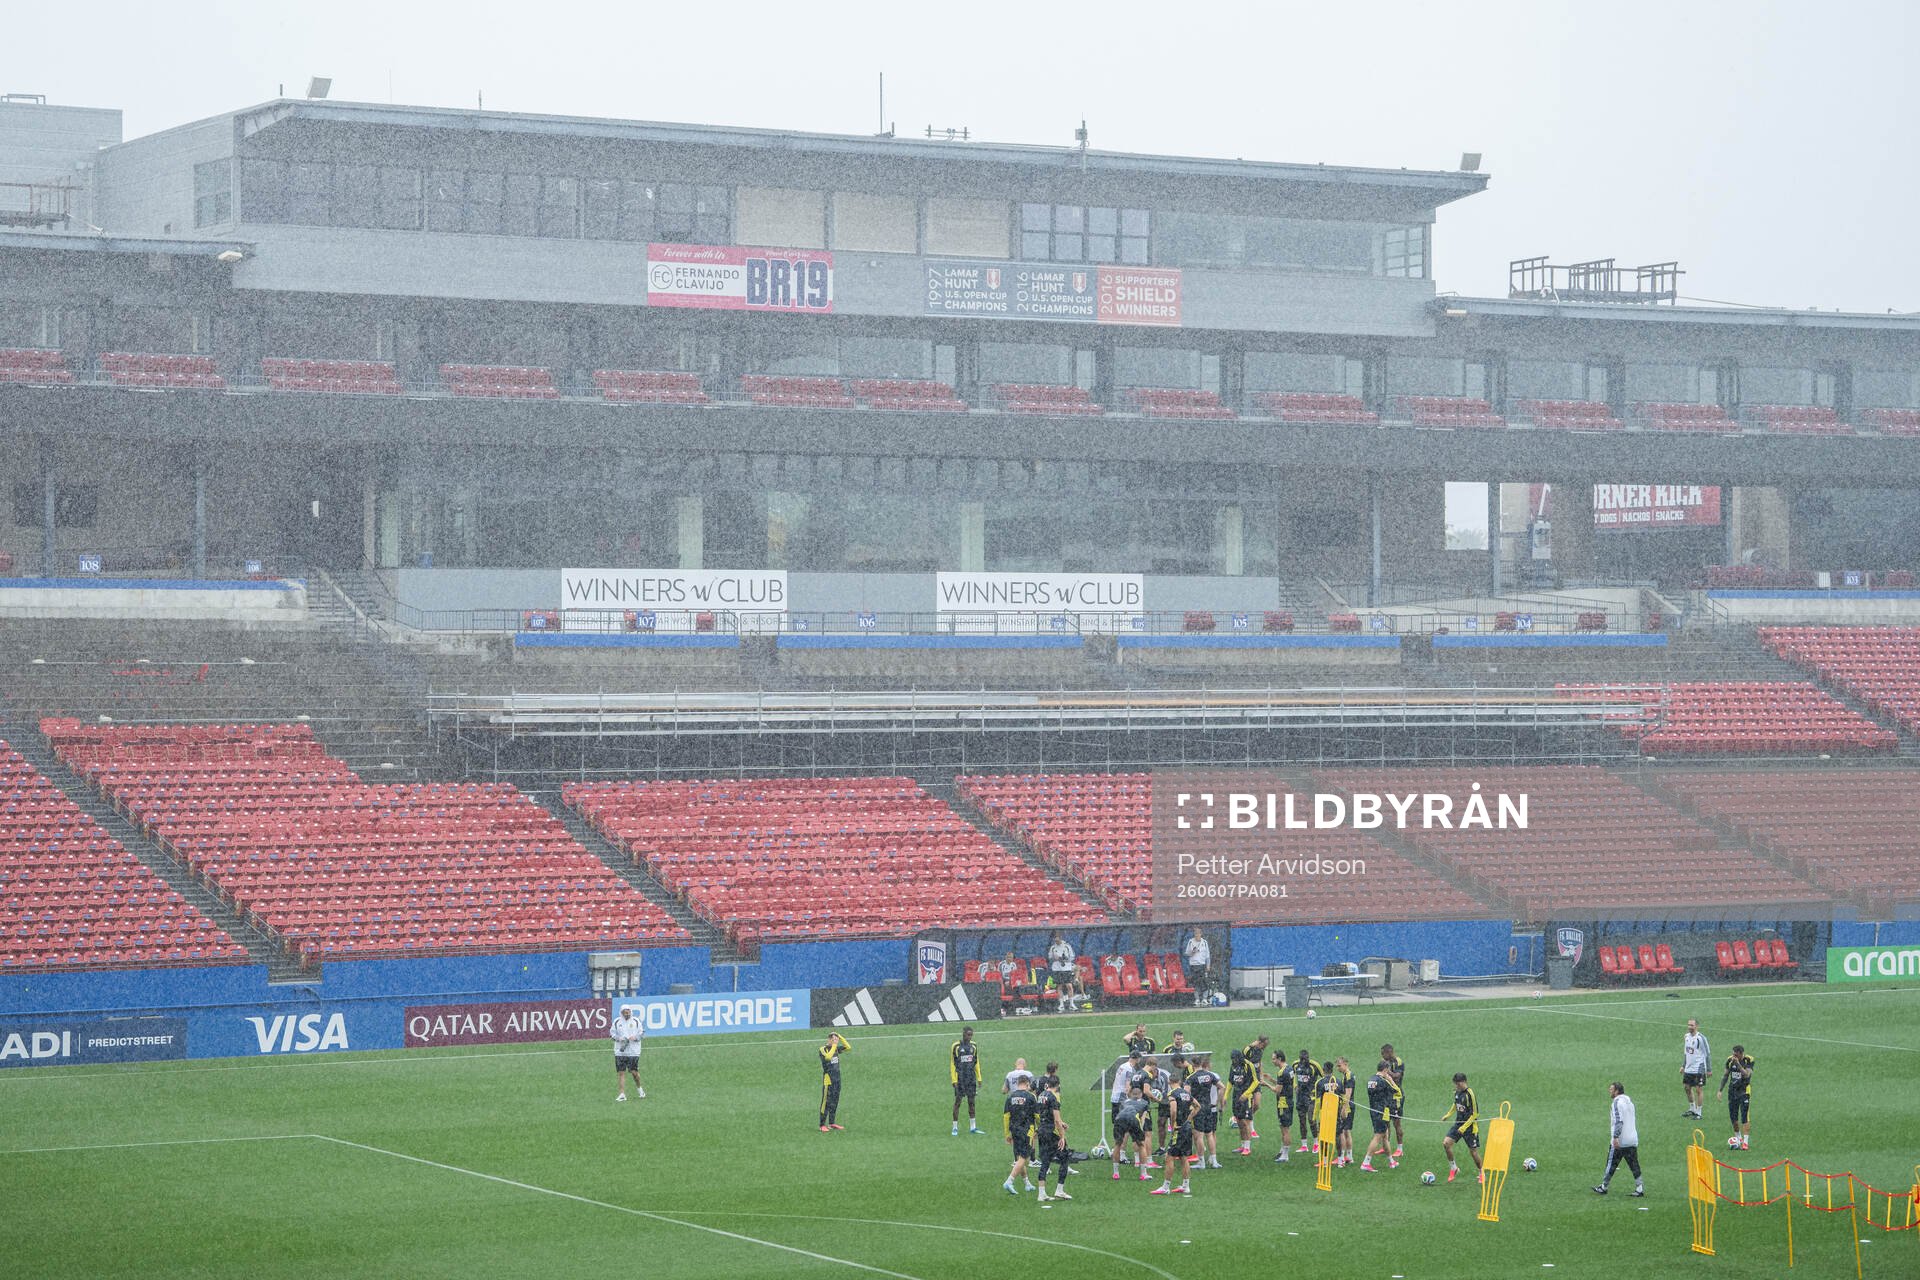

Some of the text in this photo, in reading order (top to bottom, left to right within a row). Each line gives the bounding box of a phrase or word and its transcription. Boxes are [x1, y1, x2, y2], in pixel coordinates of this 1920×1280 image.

[654, 271, 670, 284] FC
[675, 267, 740, 280] FERNANDO
[944, 268, 979, 279] LAMAR
[1031, 272, 1065, 282] LAMAR
[675, 278, 725, 291] CLAVIJO
[746, 258, 828, 308] BR19
[928, 268, 942, 308] 1997
[944, 278, 979, 290] HUNT
[1031, 282, 1065, 293] HUNT
[944, 290, 1008, 301] U.S. OPEN CUP
[1016, 272, 1029, 312] 2016
[1101, 274, 1113, 315] 2016
[1116, 286, 1177, 304] SHIELD
[944, 300, 1008, 312] CHAMPIONS
[1031, 294, 1094, 305] U.S. OPEN CUP
[1031, 303, 1095, 315] CHAMPIONS
[1115, 303, 1177, 317] WINNERS
[1622, 511, 1651, 523] NACHOS
[1655, 510, 1685, 522] SNACKS
[80, 559, 99, 571] 108
[566, 578, 686, 602] WINNERS
[717, 578, 784, 602] CLUB
[941, 581, 1051, 604] WINNERS
[1079, 581, 1140, 605] CLUB
[638, 616, 655, 628] 107
[859, 617, 875, 628] 106
[1233, 618, 1248, 628] 105
[1517, 618, 1532, 629] 104
[409, 1007, 607, 1041] QATAR AIRWAYS
[244, 1012, 349, 1053] VISA
[0, 1031, 174, 1059] ADI PREDICTSTREET
